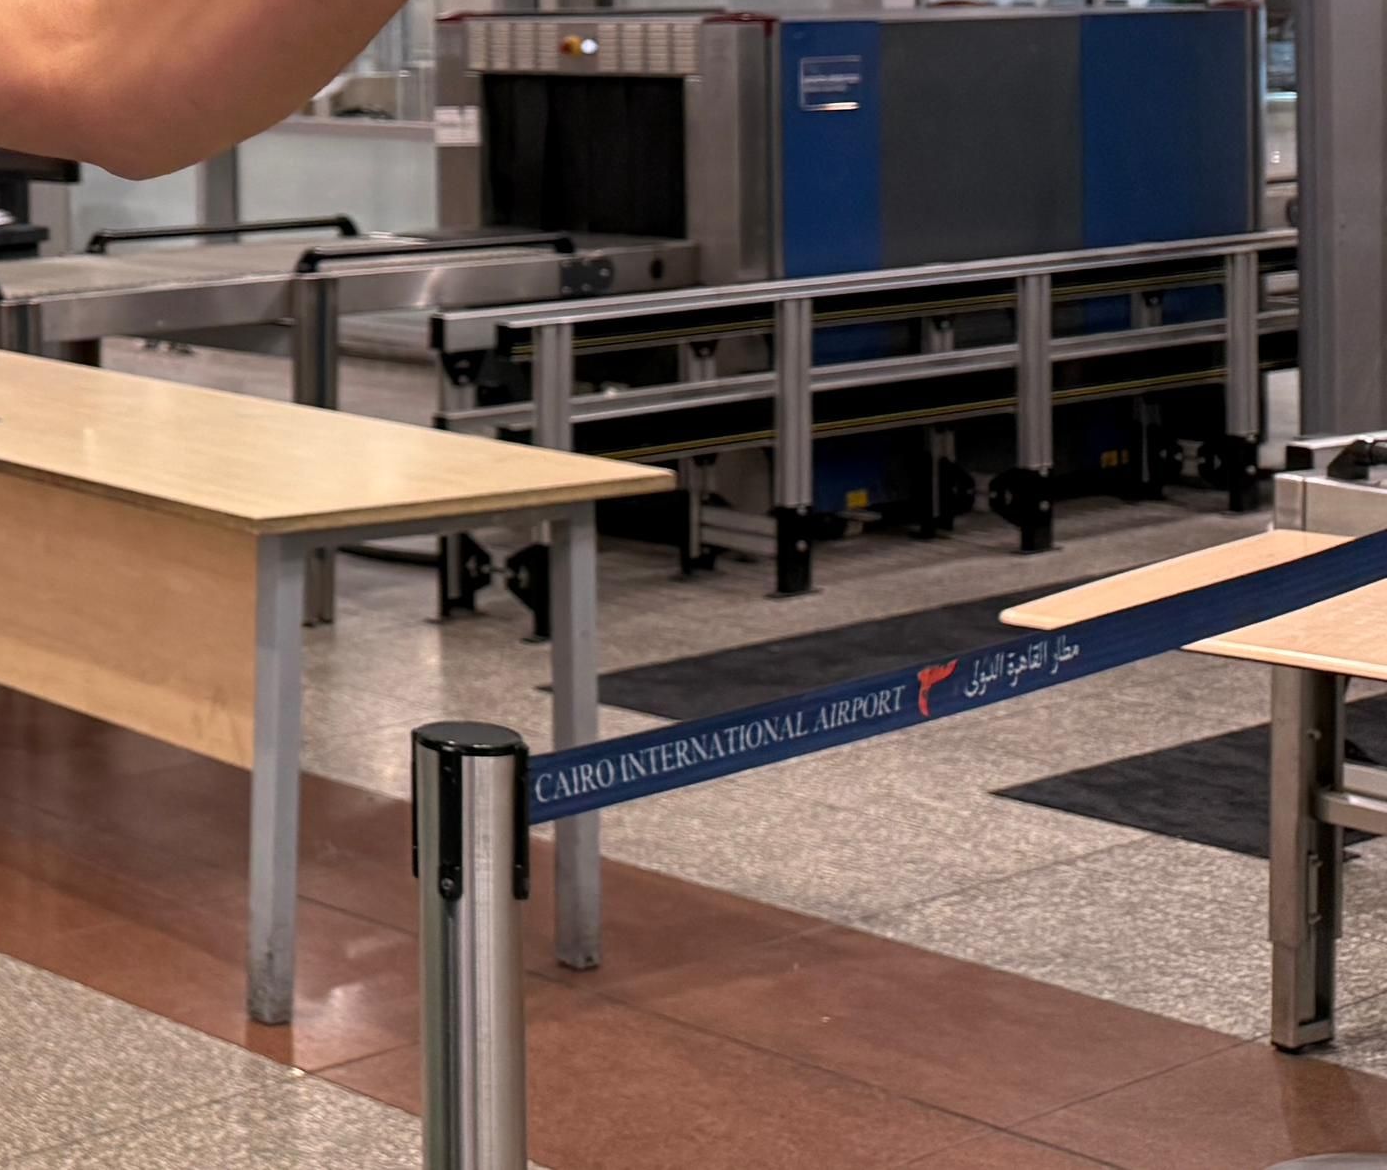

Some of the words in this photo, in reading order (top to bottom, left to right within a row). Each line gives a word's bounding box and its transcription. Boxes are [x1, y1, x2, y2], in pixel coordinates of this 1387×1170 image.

[1006, 641, 1048, 688] القاهرة
[1050, 634, 1080, 674] مطار
[534, 759, 615, 804] CAIRO
[621, 713, 808, 782] INTERNATIONAL
[813, 684, 907, 732] AIRPORT
